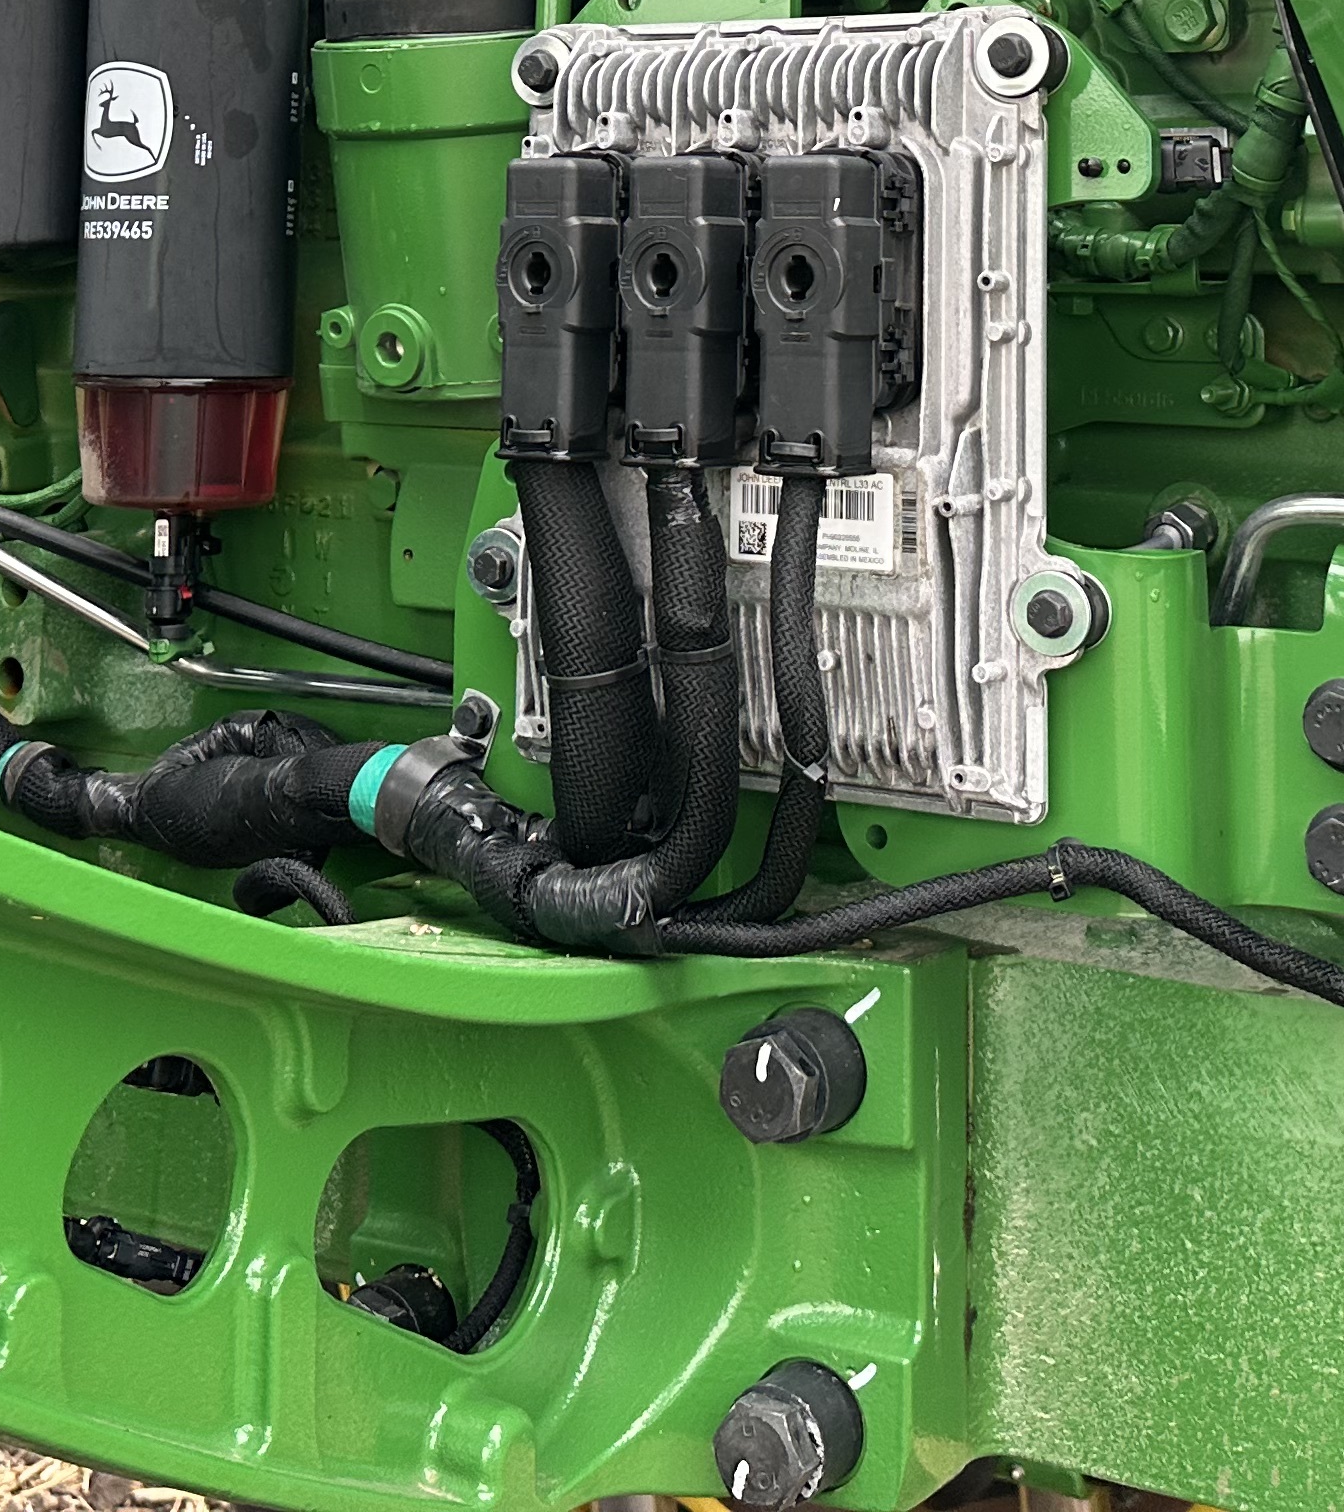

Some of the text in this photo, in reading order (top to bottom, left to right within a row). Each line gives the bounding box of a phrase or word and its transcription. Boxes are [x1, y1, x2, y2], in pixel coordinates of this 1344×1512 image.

[81, 192, 170, 211] JOHN DEERE
[84, 220, 153, 239] RE539465
[737, 472, 760, 483] JOHN
